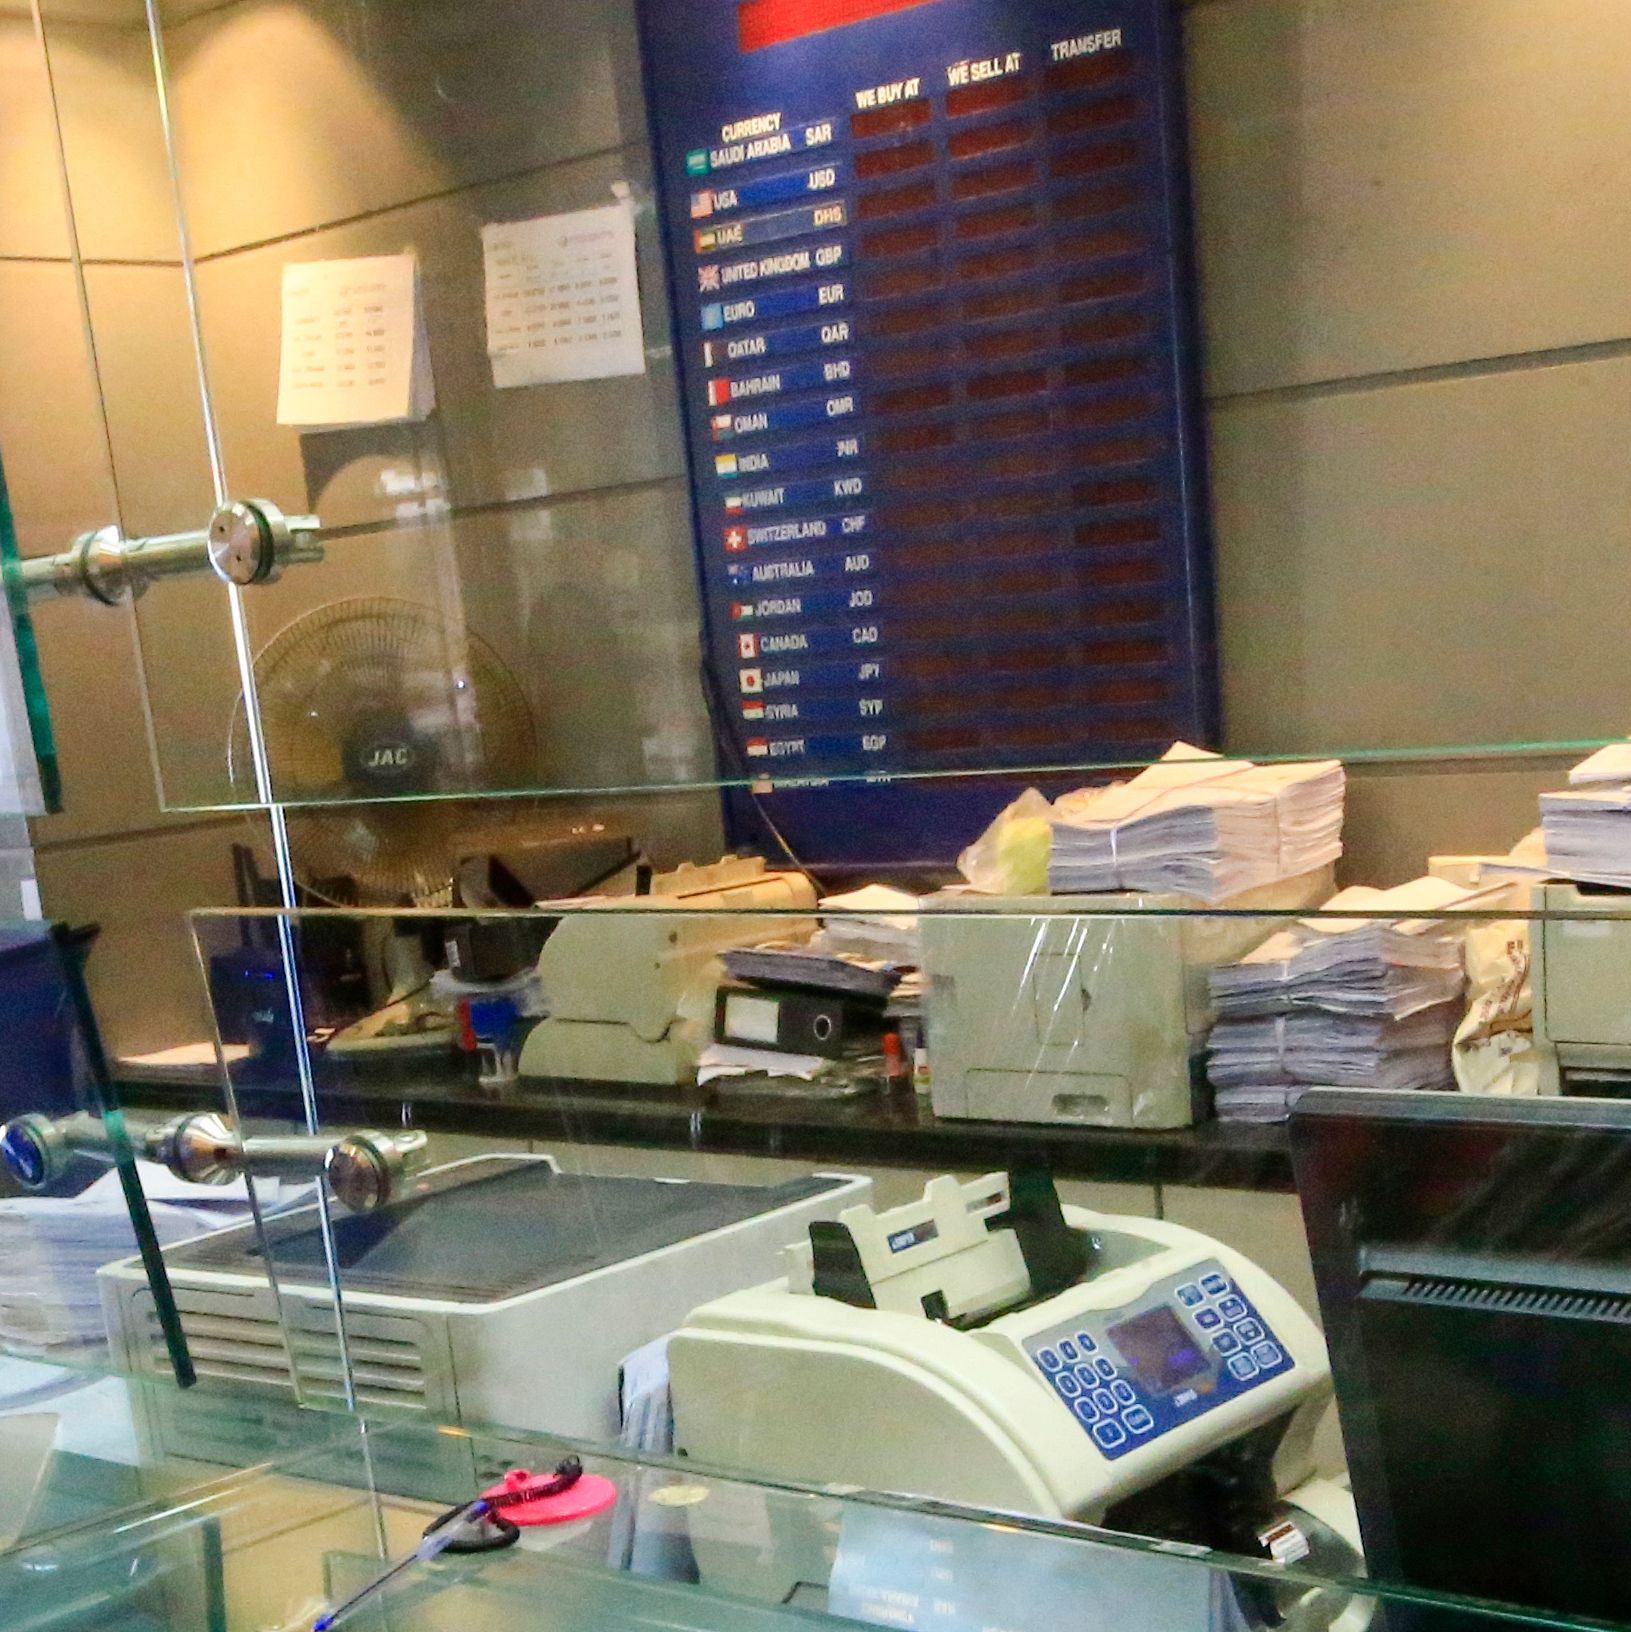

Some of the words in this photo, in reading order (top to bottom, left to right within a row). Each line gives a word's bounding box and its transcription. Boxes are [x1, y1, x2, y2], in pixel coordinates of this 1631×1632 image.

[1051, 29, 1122, 61] TRANSFER
[947, 63, 969, 87] WE
[971, 57, 1003, 82] SELL
[1004, 52, 1022, 75] AT
[855, 89, 876, 109] WE
[876, 81, 904, 106] BUY
[903, 77, 921, 99] AT
[721, 112, 782, 142] CURRENCY
[710, 145, 745, 168] SAUDI
[746, 134, 792, 160] ARABIA
[805, 123, 832, 146] SAR
[714, 189, 738, 210] USA
[807, 168, 836, 189] USD
[716, 223, 743, 244] UAE
[813, 206, 842, 226] DHS
[720, 261, 759, 284] UNITED
[759, 252, 810, 276] KINGDOM
[815, 245, 843, 266] GBP
[723, 300, 756, 322] EURO
[818, 284, 844, 305] EUR
[727, 337, 767, 358] QATAR
[821, 321, 849, 343] QAR
[730, 374, 781, 398] BAHRAIN
[824, 361, 851, 381] BHD
[734, 413, 768, 433] OMAN
[826, 396, 854, 417] OMR
[738, 453, 769, 472] INDIA
[741, 487, 785, 508] KUWAIT
[834, 477, 862, 497] KWD
[747, 520, 827, 545] SWITZERLAND
[842, 515, 866, 534] CHF
[752, 560, 815, 581] AUSTRALIA
[845, 555, 869, 572] AUD
[755, 598, 802, 617] JORDAN
[849, 590, 873, 608] JOD
[760, 634, 809, 652] CANADA
[852, 626, 878, 644] CAD
[764, 670, 800, 688] JAPAN
[858, 663, 880, 680] JPY
[765, 703, 799, 720] SYRIA
[859, 699, 883, 717] SYP
[769, 739, 805, 756] EGYPT
[862, 735, 887, 751] EGP
